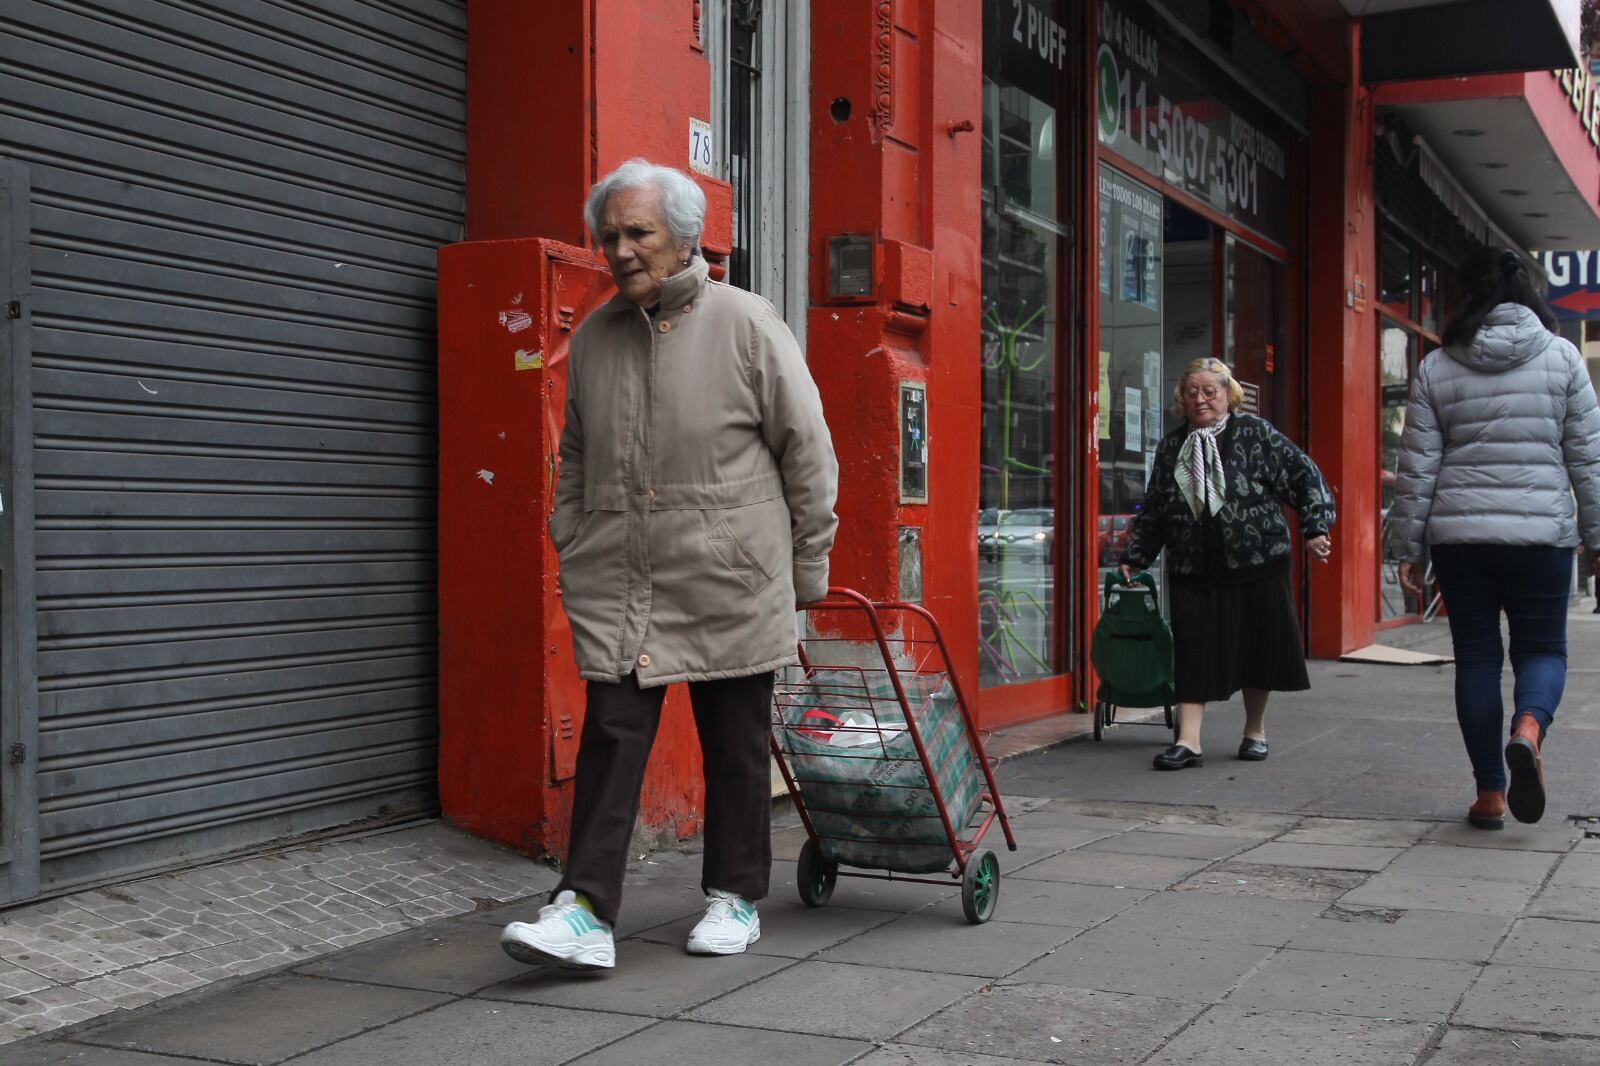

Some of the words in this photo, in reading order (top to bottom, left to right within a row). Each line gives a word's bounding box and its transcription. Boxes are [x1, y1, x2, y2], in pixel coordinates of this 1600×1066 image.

[1013, 0, 1023, 43] 2
[1028, 3, 1067, 70] PUFF
[1115, 11, 1122, 50] 4
[1124, 17, 1159, 77] SILLAS
[693, 130, 711, 165] 78
[1119, 69, 1258, 216] 11-5037-5301
[1112, 183, 1131, 206] TODOS
[1132, 192, 1143, 212] LOS
[1544, 250, 1600, 287] GY
